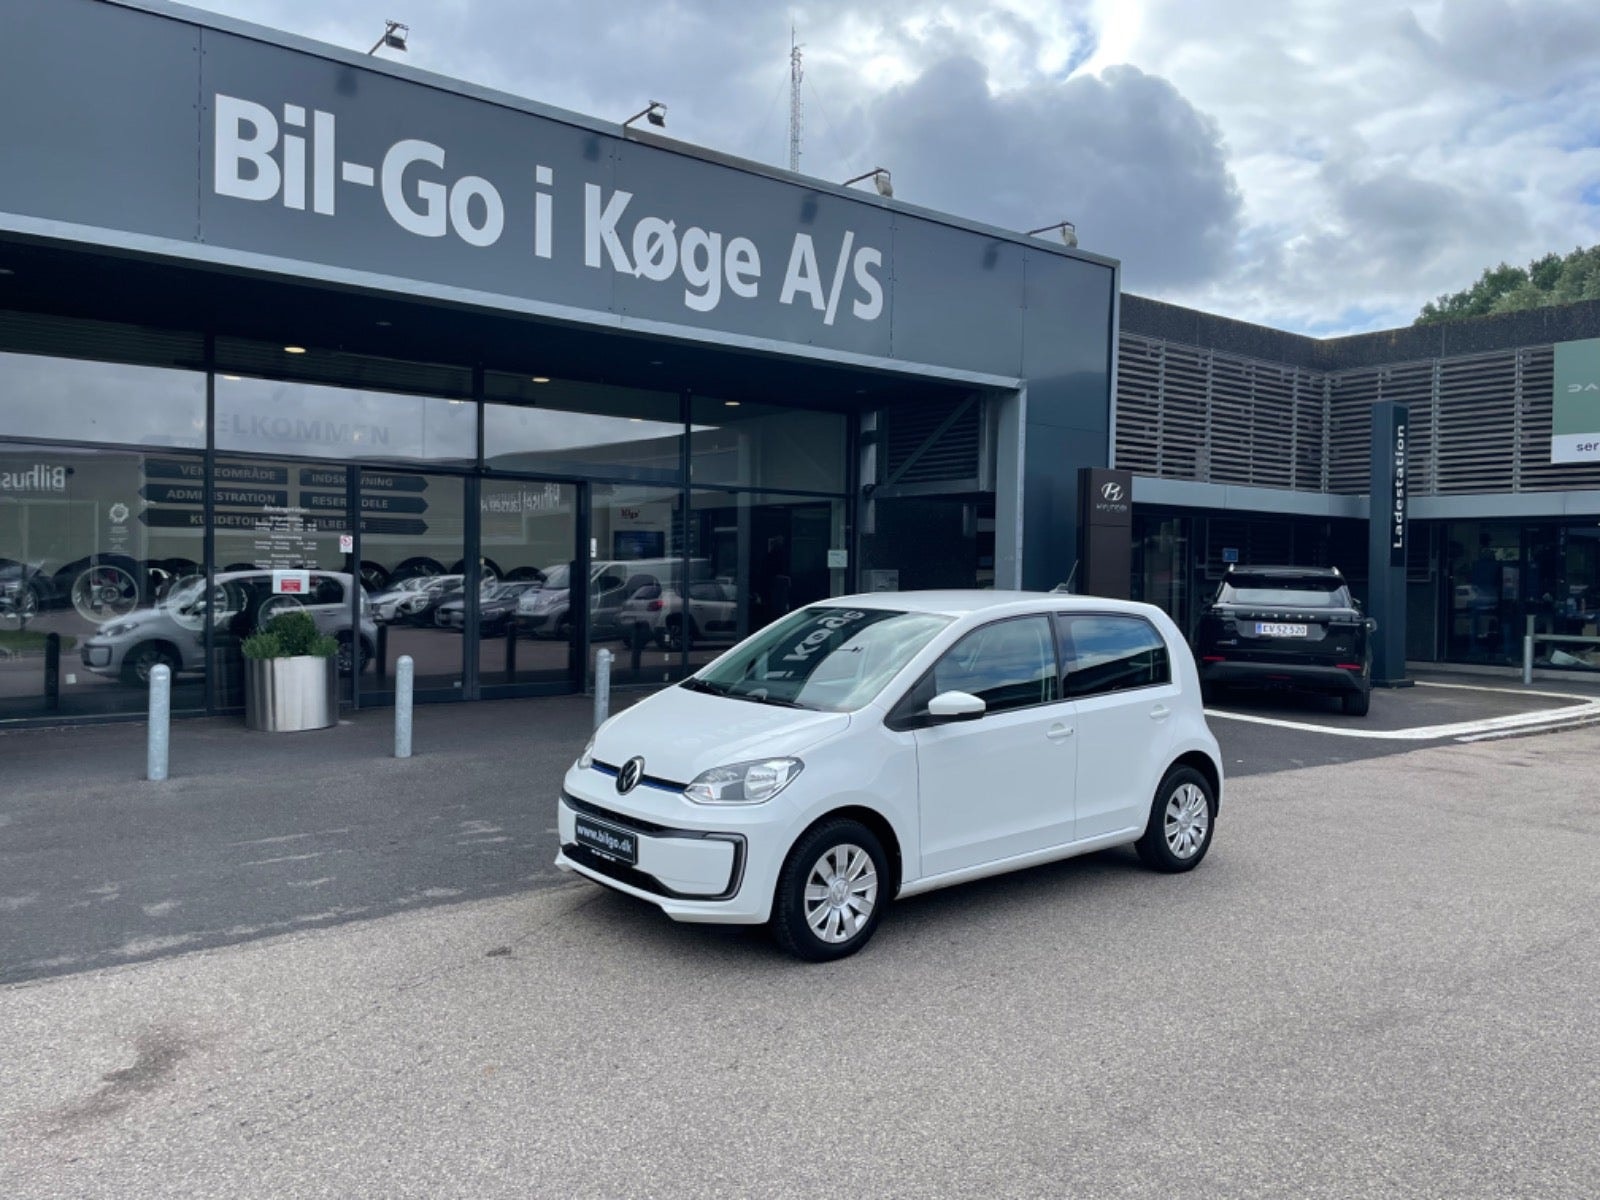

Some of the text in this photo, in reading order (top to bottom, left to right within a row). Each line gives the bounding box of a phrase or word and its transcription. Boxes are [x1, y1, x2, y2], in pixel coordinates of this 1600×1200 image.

[214, 93, 884, 327] Bil-Go i Køge A/S
[180, 465, 276, 481] VENEOMRÅDE
[1393, 424, 1405, 549] Ladestation
[166, 489, 276, 504] ADMIISTRATION
[312, 495, 389, 509] RESERDELE
